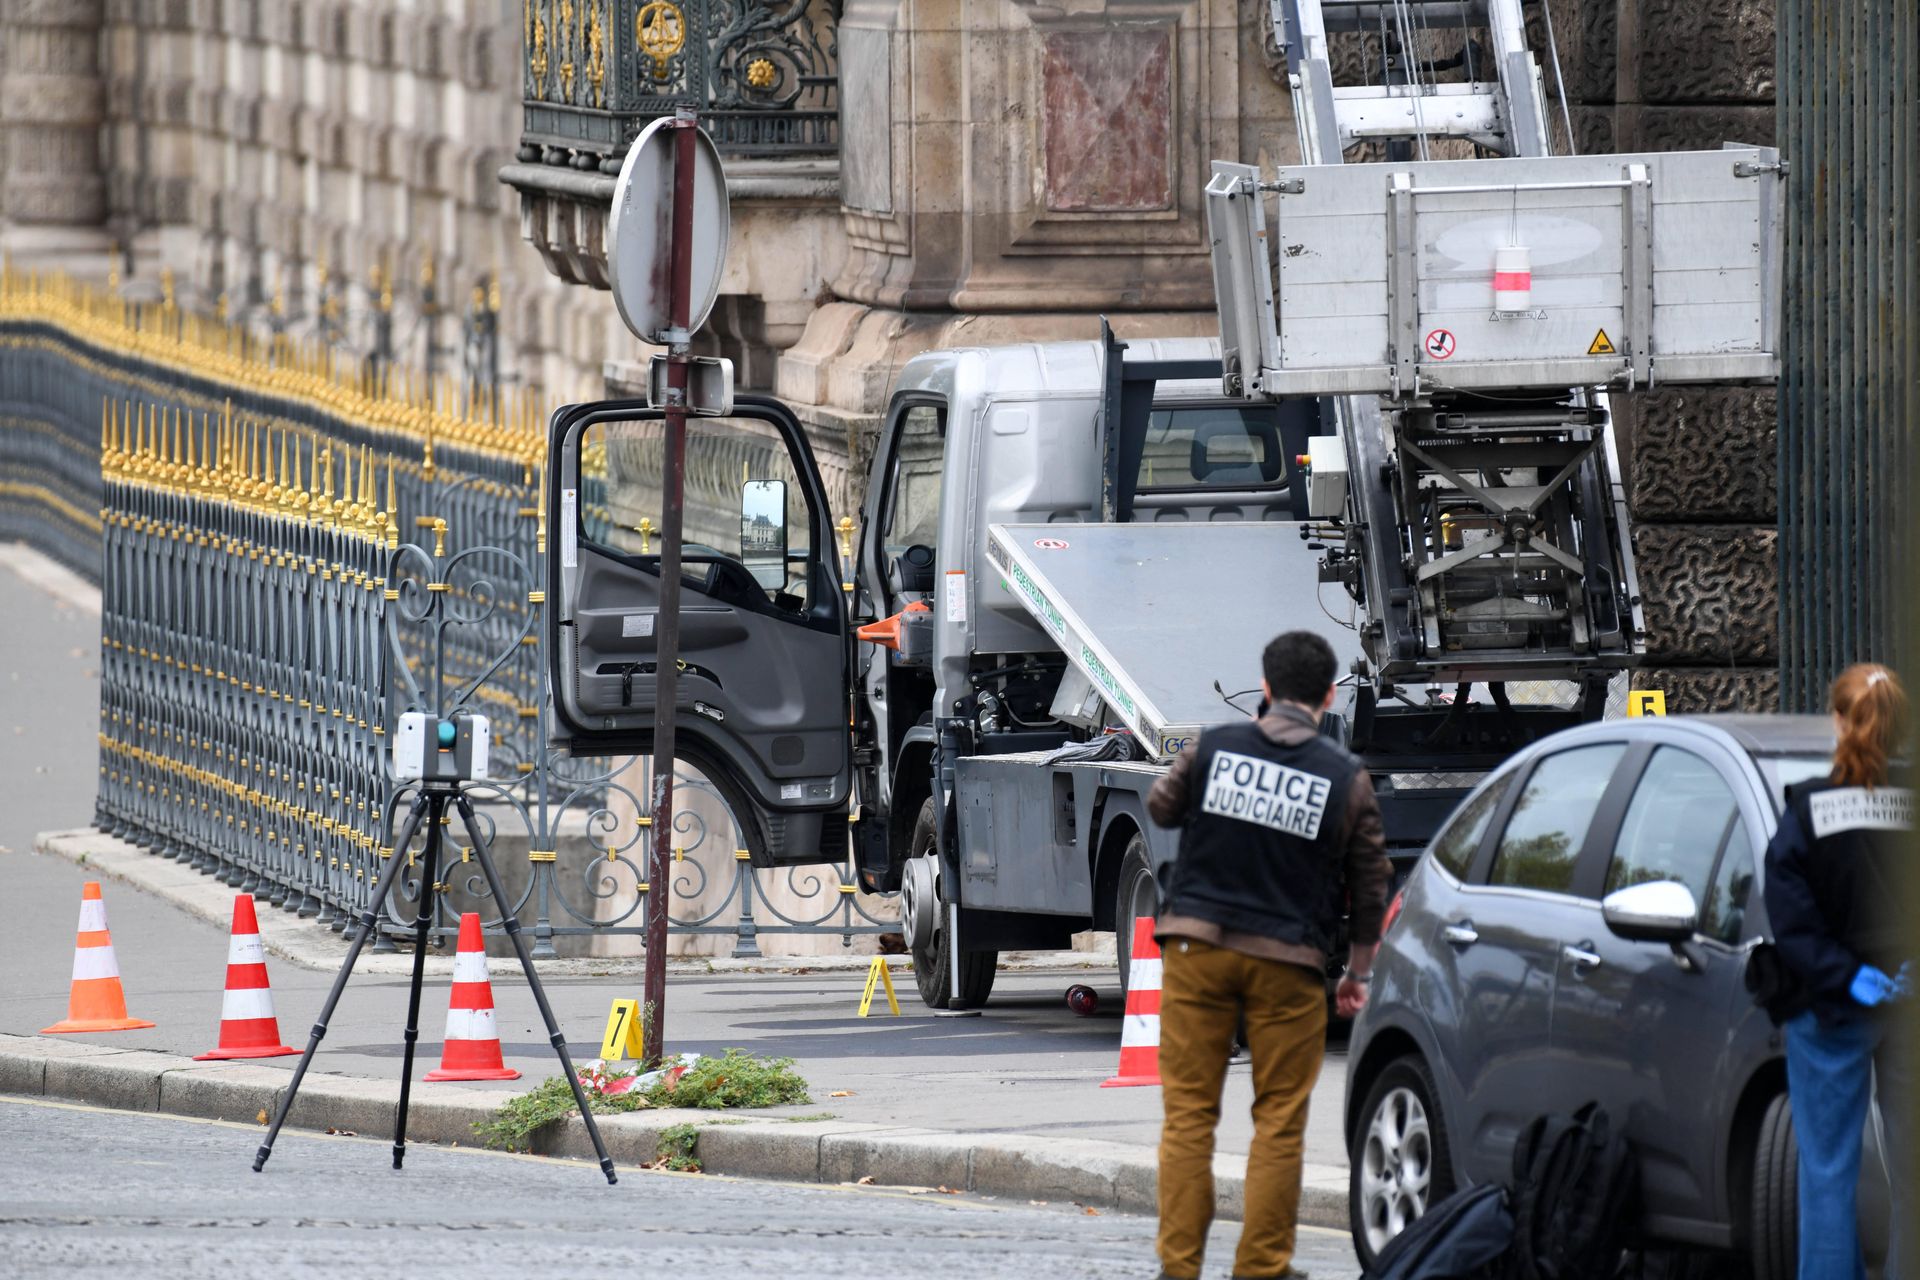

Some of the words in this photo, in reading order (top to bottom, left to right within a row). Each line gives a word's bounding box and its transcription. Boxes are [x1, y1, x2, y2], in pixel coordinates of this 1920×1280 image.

[1012, 564, 1044, 608] PEDESTRIAN
[1044, 602, 1065, 634] TUNNEL
[1082, 644, 1114, 692] PEDESTRIAN
[1114, 683, 1135, 717] TUNNEL
[1212, 756, 1326, 808] POLICE
[1813, 795, 1858, 813] POLICE
[1208, 787, 1321, 835] JUDICIAIRE
[610, 1006, 627, 1047] 7
